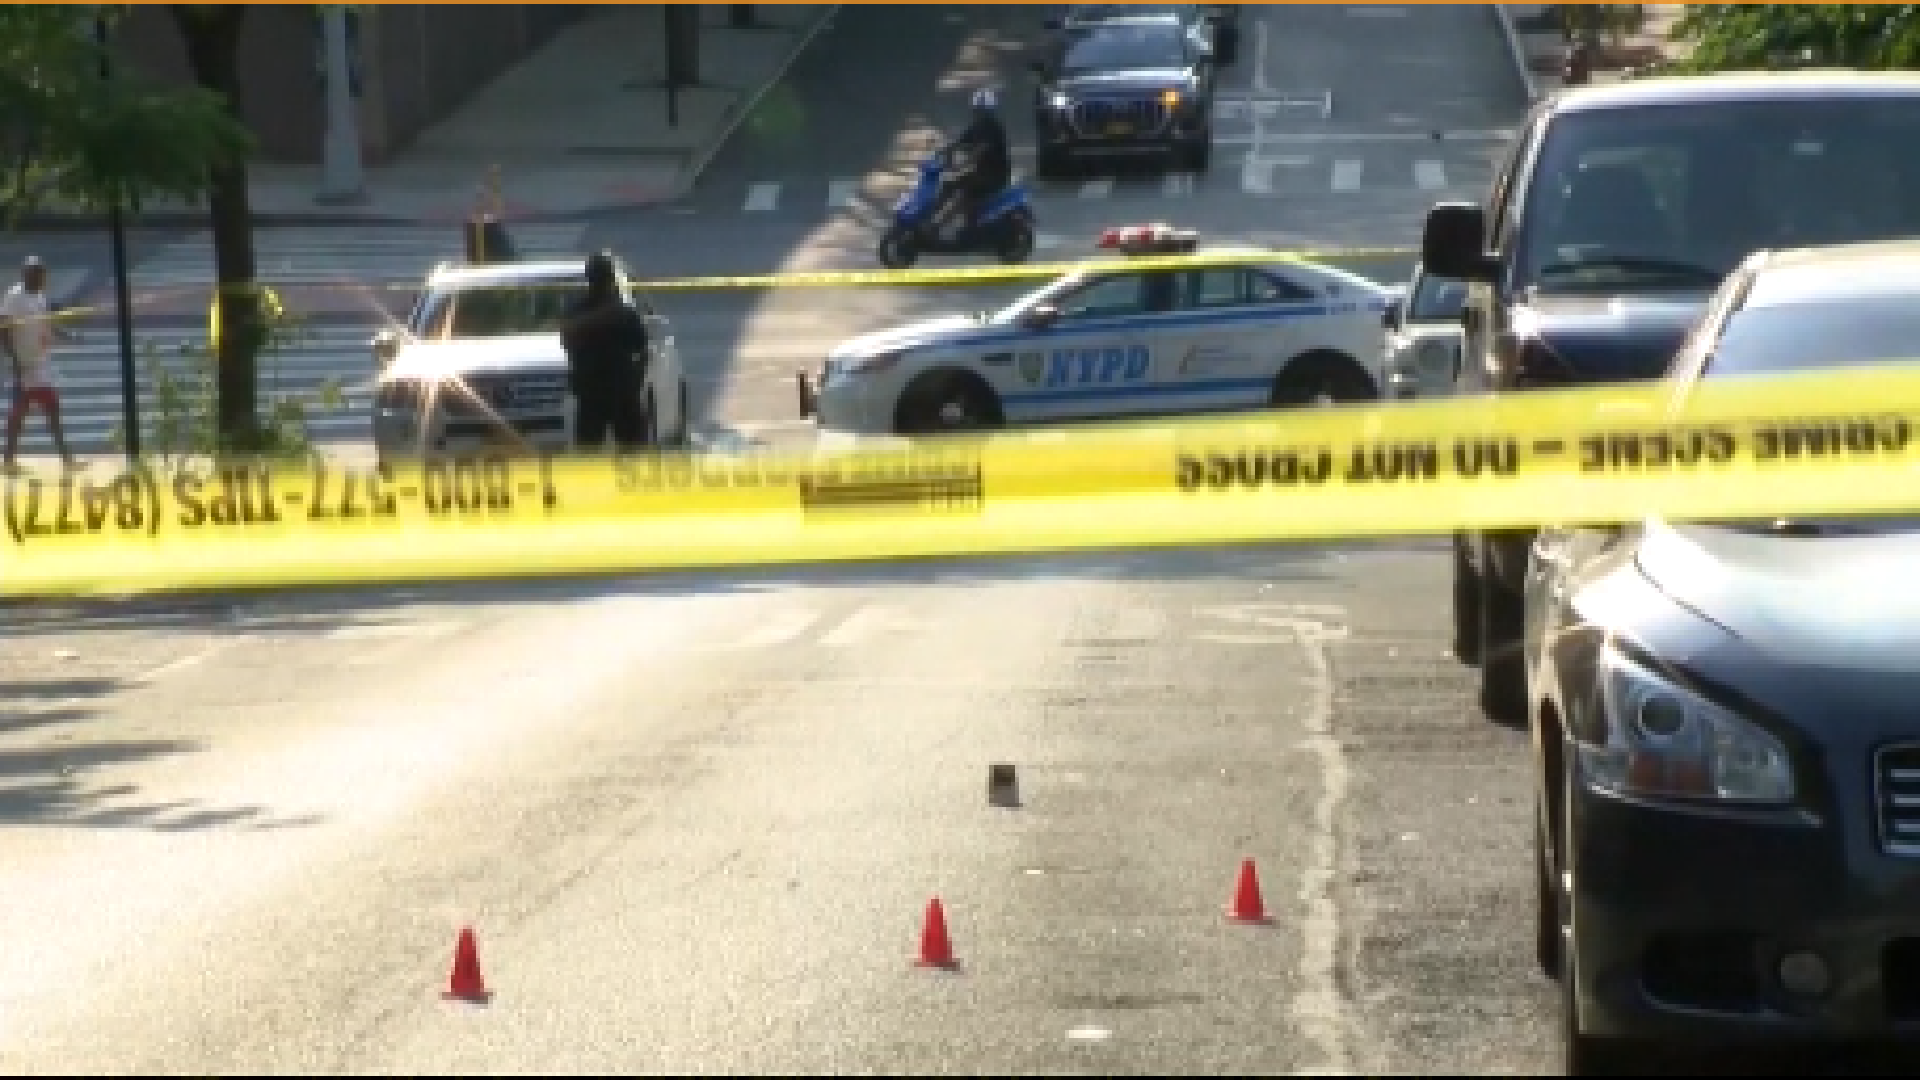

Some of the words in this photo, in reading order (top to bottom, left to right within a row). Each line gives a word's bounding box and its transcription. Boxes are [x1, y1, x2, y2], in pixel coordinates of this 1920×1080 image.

[1048, 345, 1150, 387] NYPD
[1344, 440, 1437, 483] NOT
[1453, 434, 1520, 479] DO
[1580, 424, 1735, 473] SCENE
[4, 466, 160, 545] (8477)
